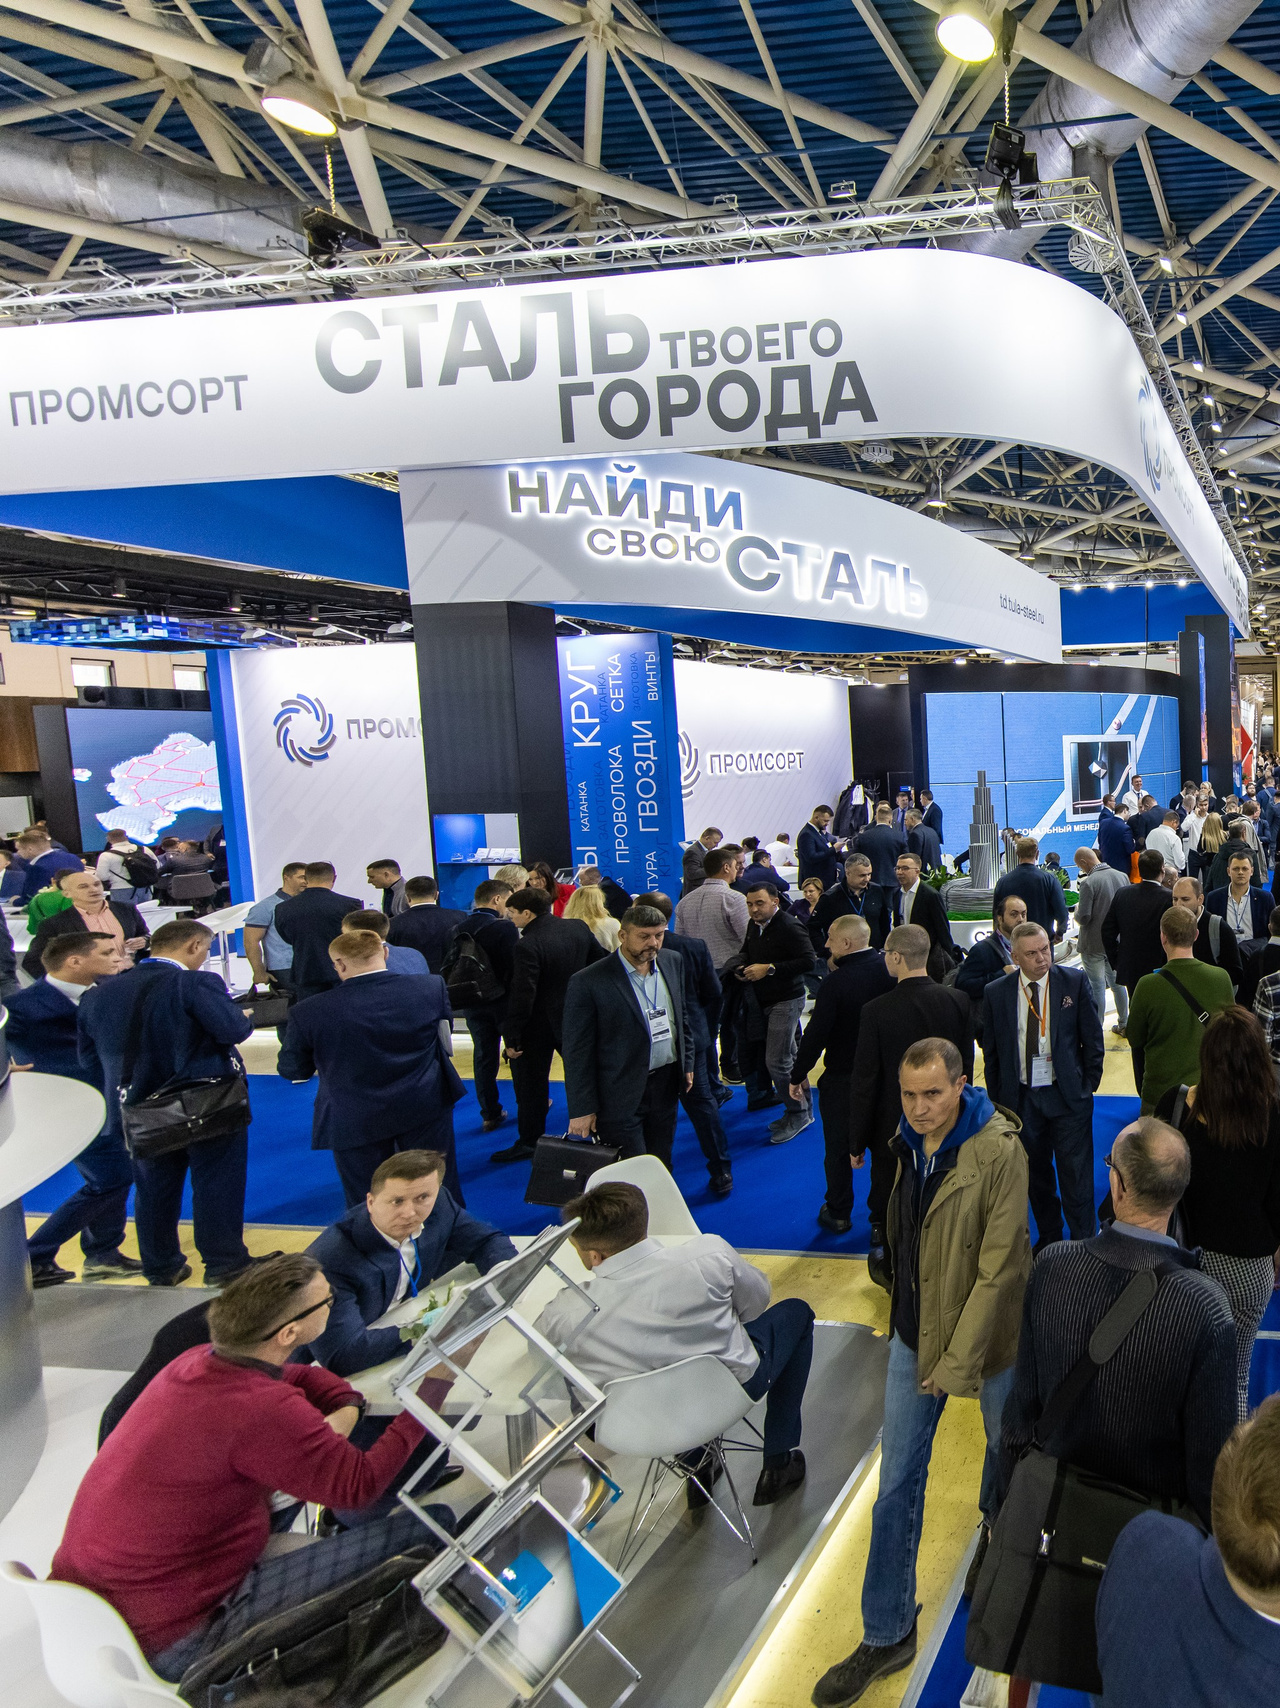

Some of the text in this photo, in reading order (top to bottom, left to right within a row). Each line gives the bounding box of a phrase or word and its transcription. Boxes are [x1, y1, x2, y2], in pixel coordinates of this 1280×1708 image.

[315, 290, 844, 395] СТАЛЬ ТВОЕГО
[10, 373, 249, 428] ПРОМСОРТ
[559, 359, 879, 444] ГОРОДА
[508, 463, 744, 532] НАЙДИ
[585, 526, 929, 618] СВОЮ СТАЛЬ
[566, 650, 602, 748] КРУГ
[607, 652, 625, 713] СЕТКА
[629, 651, 642, 713] ЗАГОТОВКА
[644, 651, 659, 701] ВИНТЫ
[346, 717, 422, 740] ПРОМ
[632, 720, 660, 833] ГВОЗДИ
[706, 751, 805, 774] ПРОМСОРТ
[577, 780, 591, 832] КАТАНКА
[593, 760, 609, 841] ЗАГОТОВКА
[608, 744, 631, 864] ПРОВОЛОКА
[999, 822, 1100, 837] ПСОНАЛЬНЫЙ МЕНЕД
